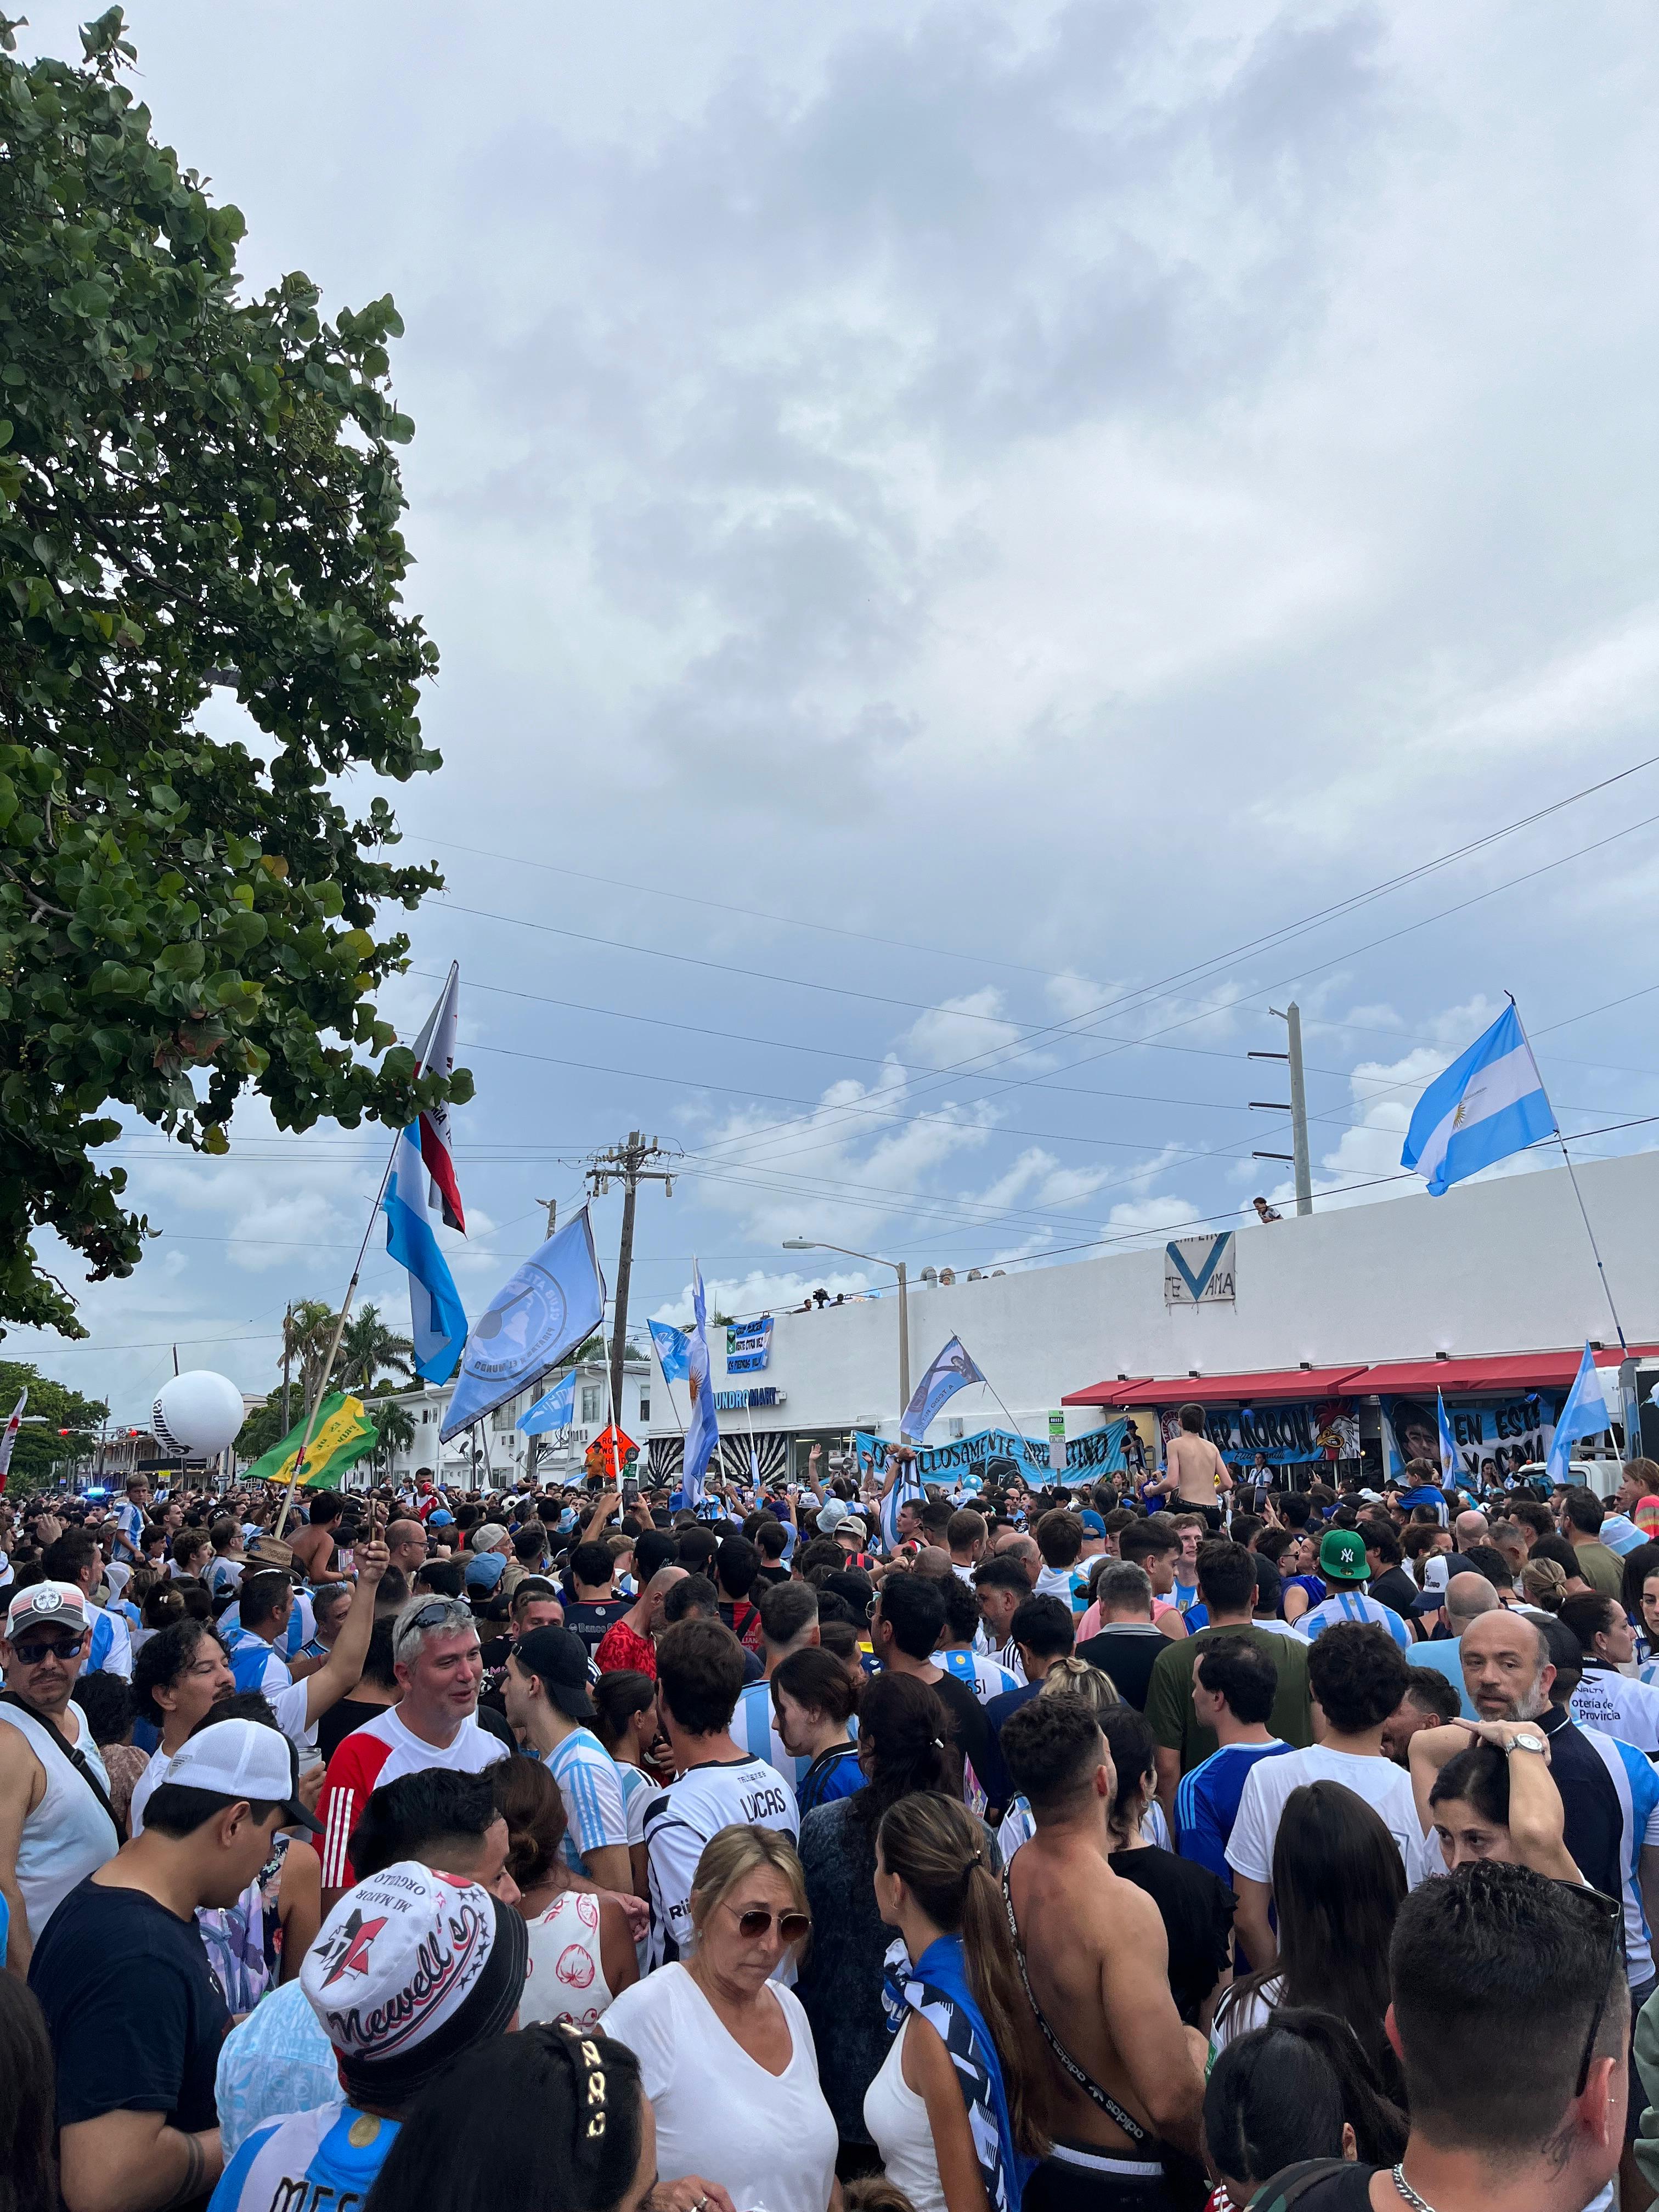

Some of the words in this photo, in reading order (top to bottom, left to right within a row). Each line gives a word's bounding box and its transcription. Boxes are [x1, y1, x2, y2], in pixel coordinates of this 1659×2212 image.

[1205, 1273, 1235, 1295] AMA
[153, 1399, 194, 1455] Quilmes
[1454, 1413, 1483, 1447] EN
[1495, 1400, 1541, 1441] ESTE
[1341, 1548, 1354, 1563] NY
[578, 1623, 606, 1633] Banco
[1602, 1698, 1613, 1709] de
[740, 1787, 786, 1822] LUCAS
[374, 1873, 426, 1895] ORGULLO
[356, 1889, 393, 1907] MAYOR
[392, 1900, 414, 1913] MI
[326, 1904, 478, 2044] Newell's
[1052, 2040, 1086, 2082] adidas
[1106, 2100, 1144, 2138] adidas
